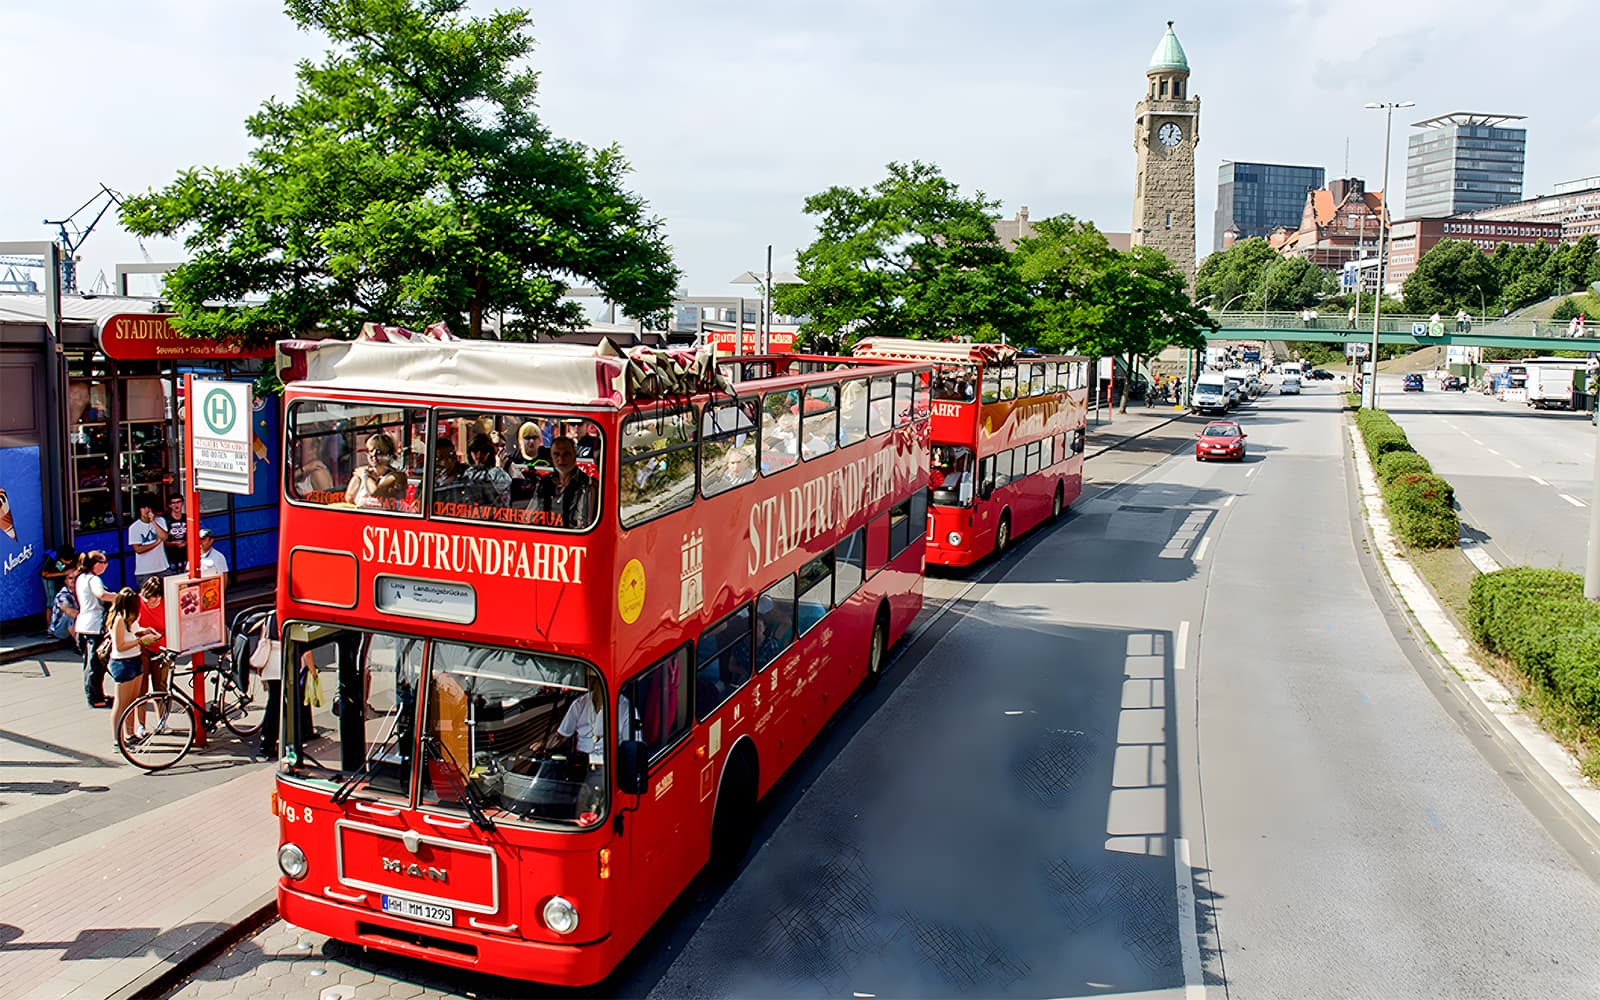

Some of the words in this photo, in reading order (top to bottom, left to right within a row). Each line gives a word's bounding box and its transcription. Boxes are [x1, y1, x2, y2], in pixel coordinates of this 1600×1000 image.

[211, 398, 228, 425] H
[930, 403, 962, 418] AHRT
[747, 445, 897, 577] STADTRUNDFAHRT
[362, 525, 587, 585] STADTRUNDFAHRT
[303, 806, 314, 824] 8
[424, 905, 452, 922] 1295
